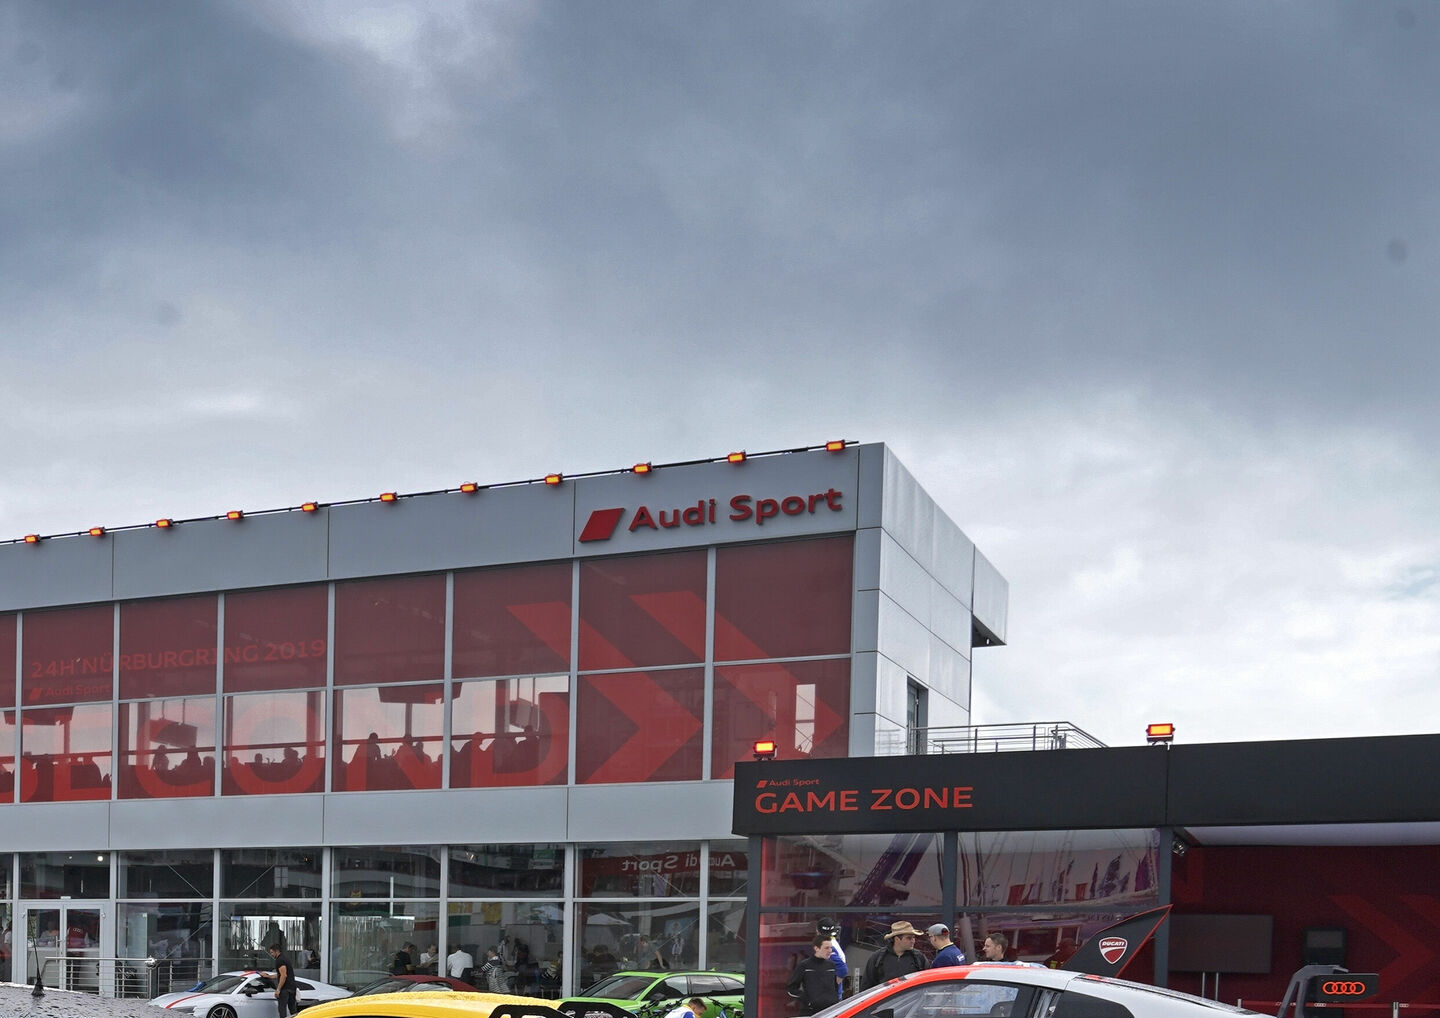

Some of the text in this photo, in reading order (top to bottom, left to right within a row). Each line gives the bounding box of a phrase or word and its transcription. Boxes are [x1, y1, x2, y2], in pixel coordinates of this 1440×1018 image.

[628, 488, 843, 532] Audi Sport
[31, 659, 75, 678] 24H
[264, 639, 326, 662] 2019
[45, 686, 74, 698] Audi
[769, 778, 820, 788] Audi Sport
[755, 786, 974, 814] GAME ZONE
